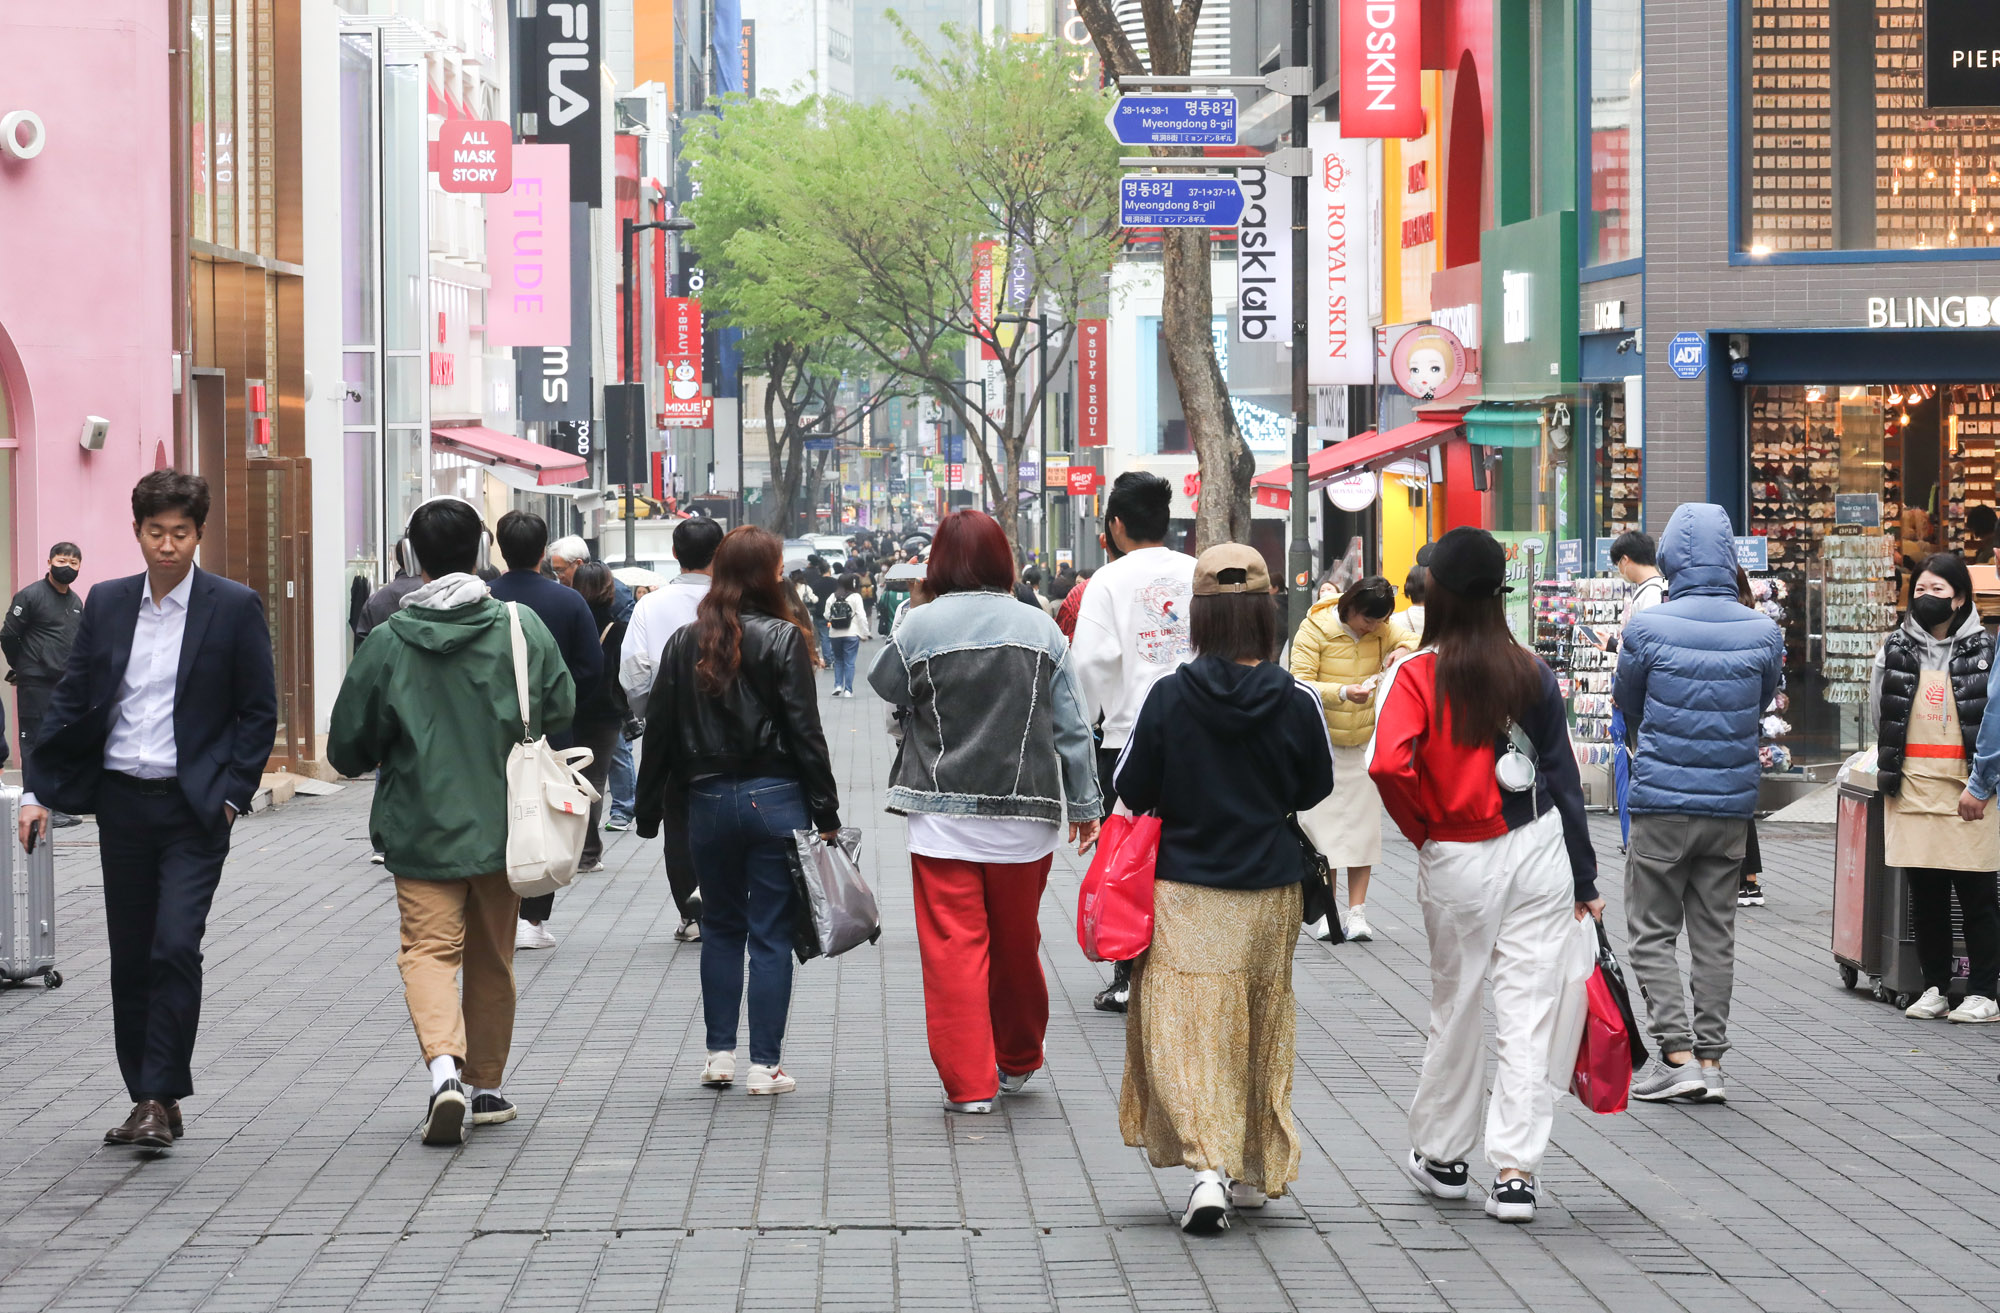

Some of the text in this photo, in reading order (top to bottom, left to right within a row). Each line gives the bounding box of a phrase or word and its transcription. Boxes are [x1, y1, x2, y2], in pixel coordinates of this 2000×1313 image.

[1366, 0, 1396, 110] DSKIN
[1952, 50, 2000, 68] PIER
[547, 3, 589, 126] FILA
[1122, 106, 1169, 115] 38-14 38-1
[1185, 101, 1233, 116] 명동8길
[1142, 119, 1233, 130] Myeongdong 8-gil
[462, 131, 489, 144] ALL
[454, 150, 496, 163] MASK
[452, 168, 498, 182] STORY
[1125, 182, 1173, 197] 명동8길
[1188, 188, 1236, 197] 37-1 37-14
[1125, 200, 1216, 211] Myeongdong 8-gil
[513, 178, 543, 313] ETUDE
[1240, 166, 1277, 340] masklab
[1328, 203, 1347, 359] ROYAL SKIN
[1675, 347, 1702, 363] ADT
[1088, 338, 1098, 437] SUPY SEOUL
[665, 402, 701, 412] MIXUE
